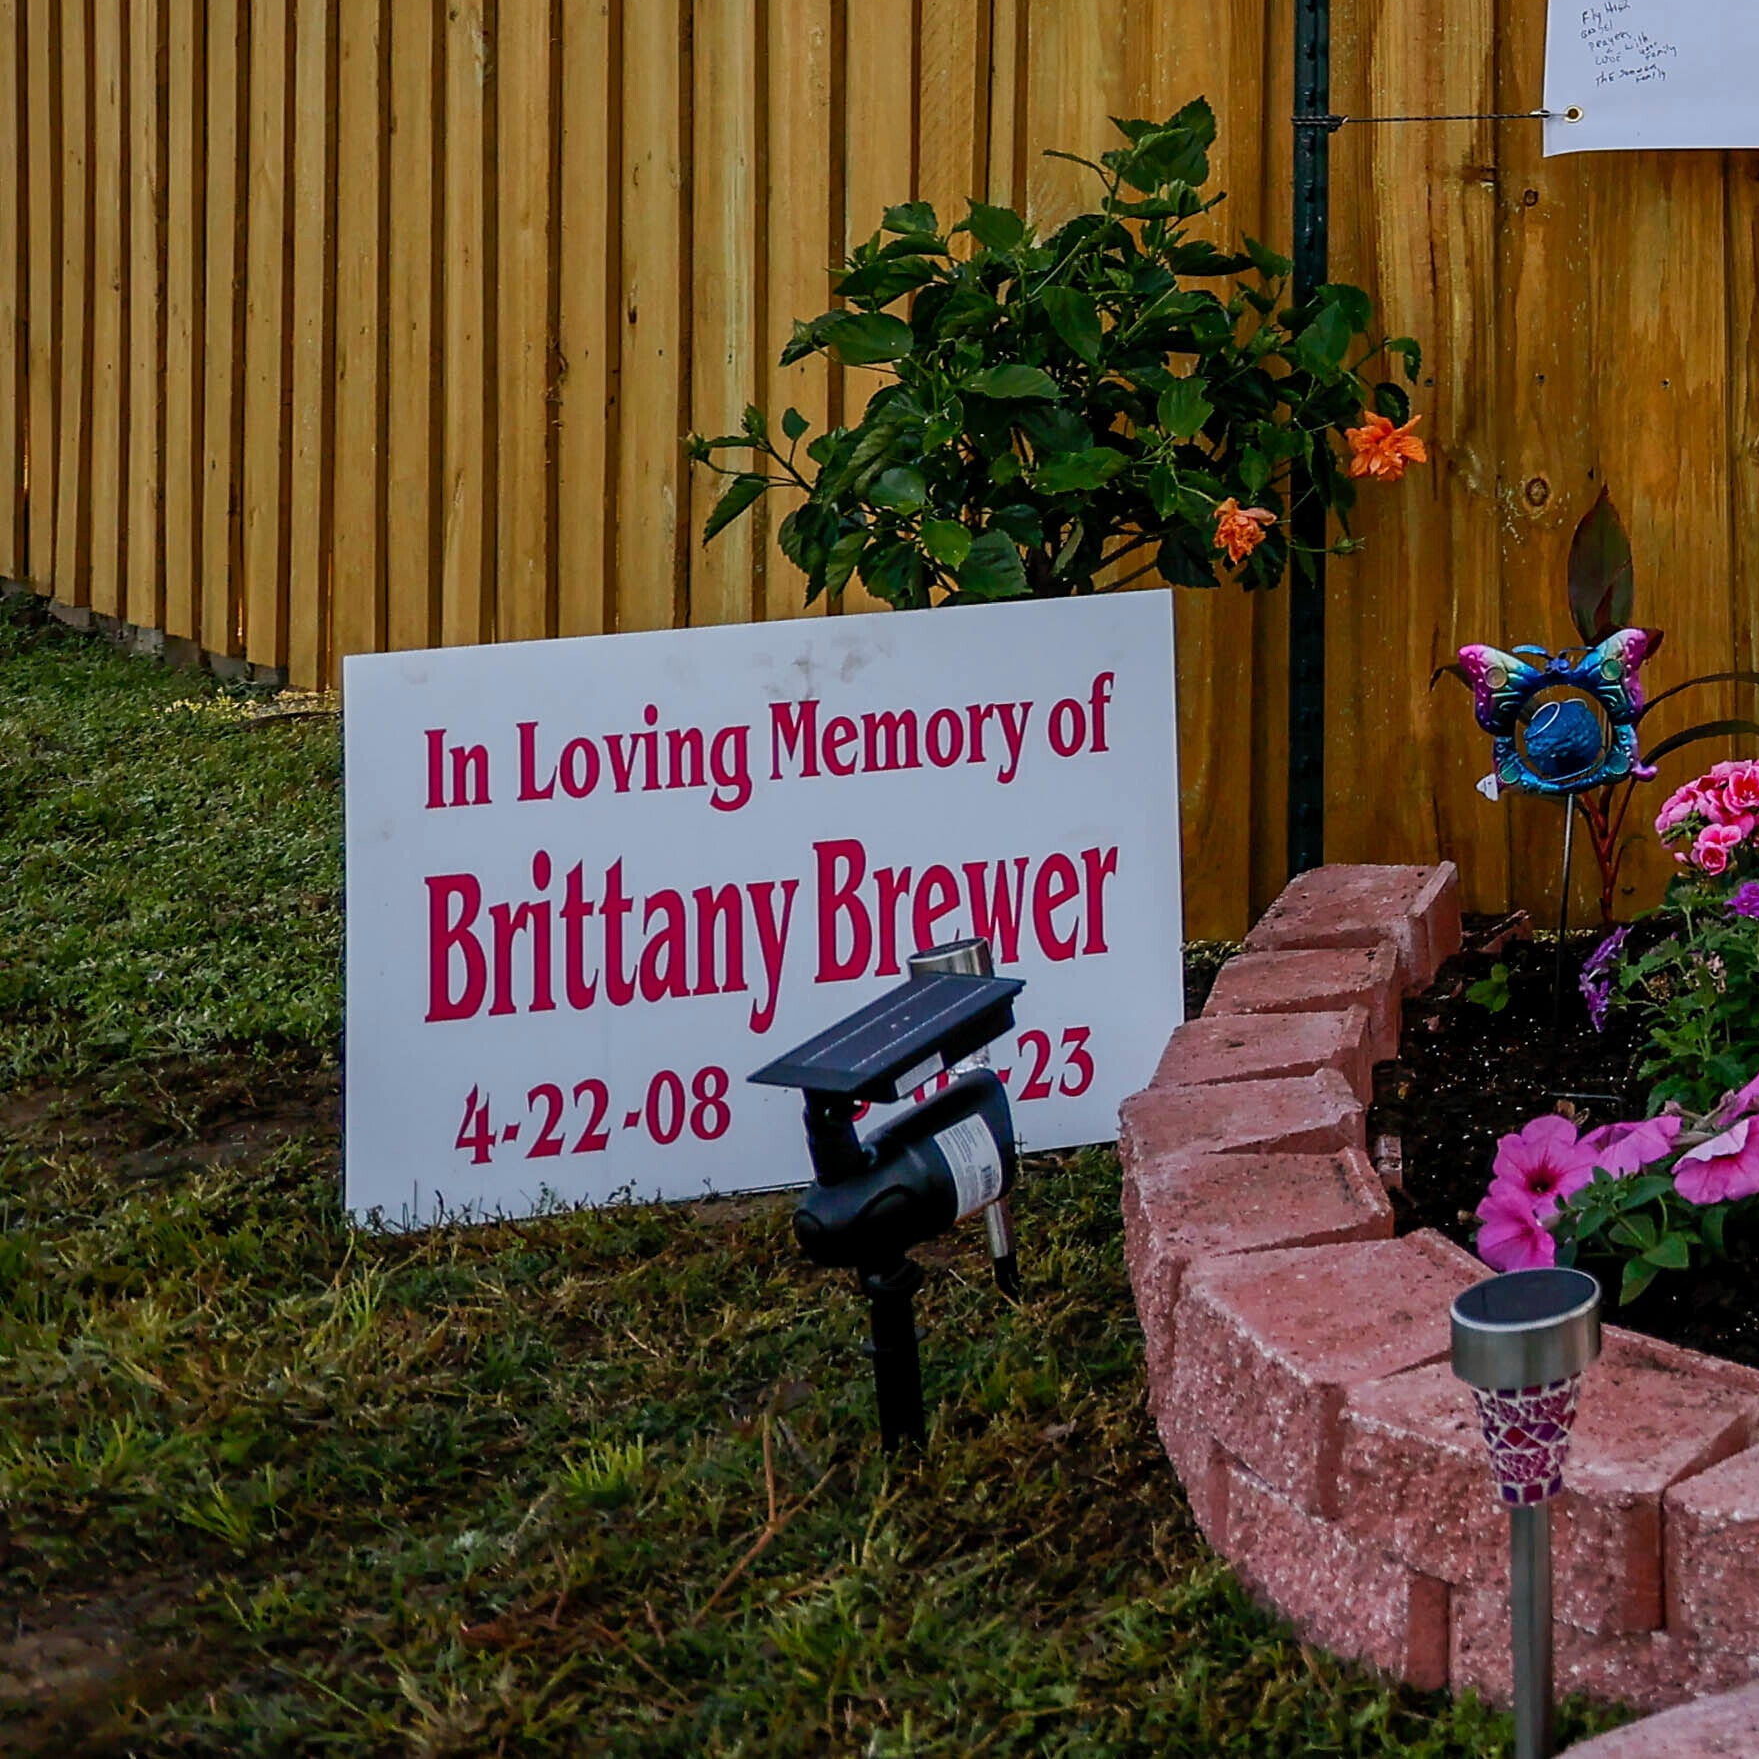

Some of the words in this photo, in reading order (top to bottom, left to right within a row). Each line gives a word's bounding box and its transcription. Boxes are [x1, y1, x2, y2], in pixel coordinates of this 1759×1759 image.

[427, 730, 490, 808] In
[519, 706, 751, 811] Loving
[771, 701, 1031, 783] Memory
[1049, 673, 1113, 756] of
[426, 851, 797, 1033] Brittany
[814, 840, 1117, 982] Brewer
[458, 1067, 729, 1163] 4-22-08
